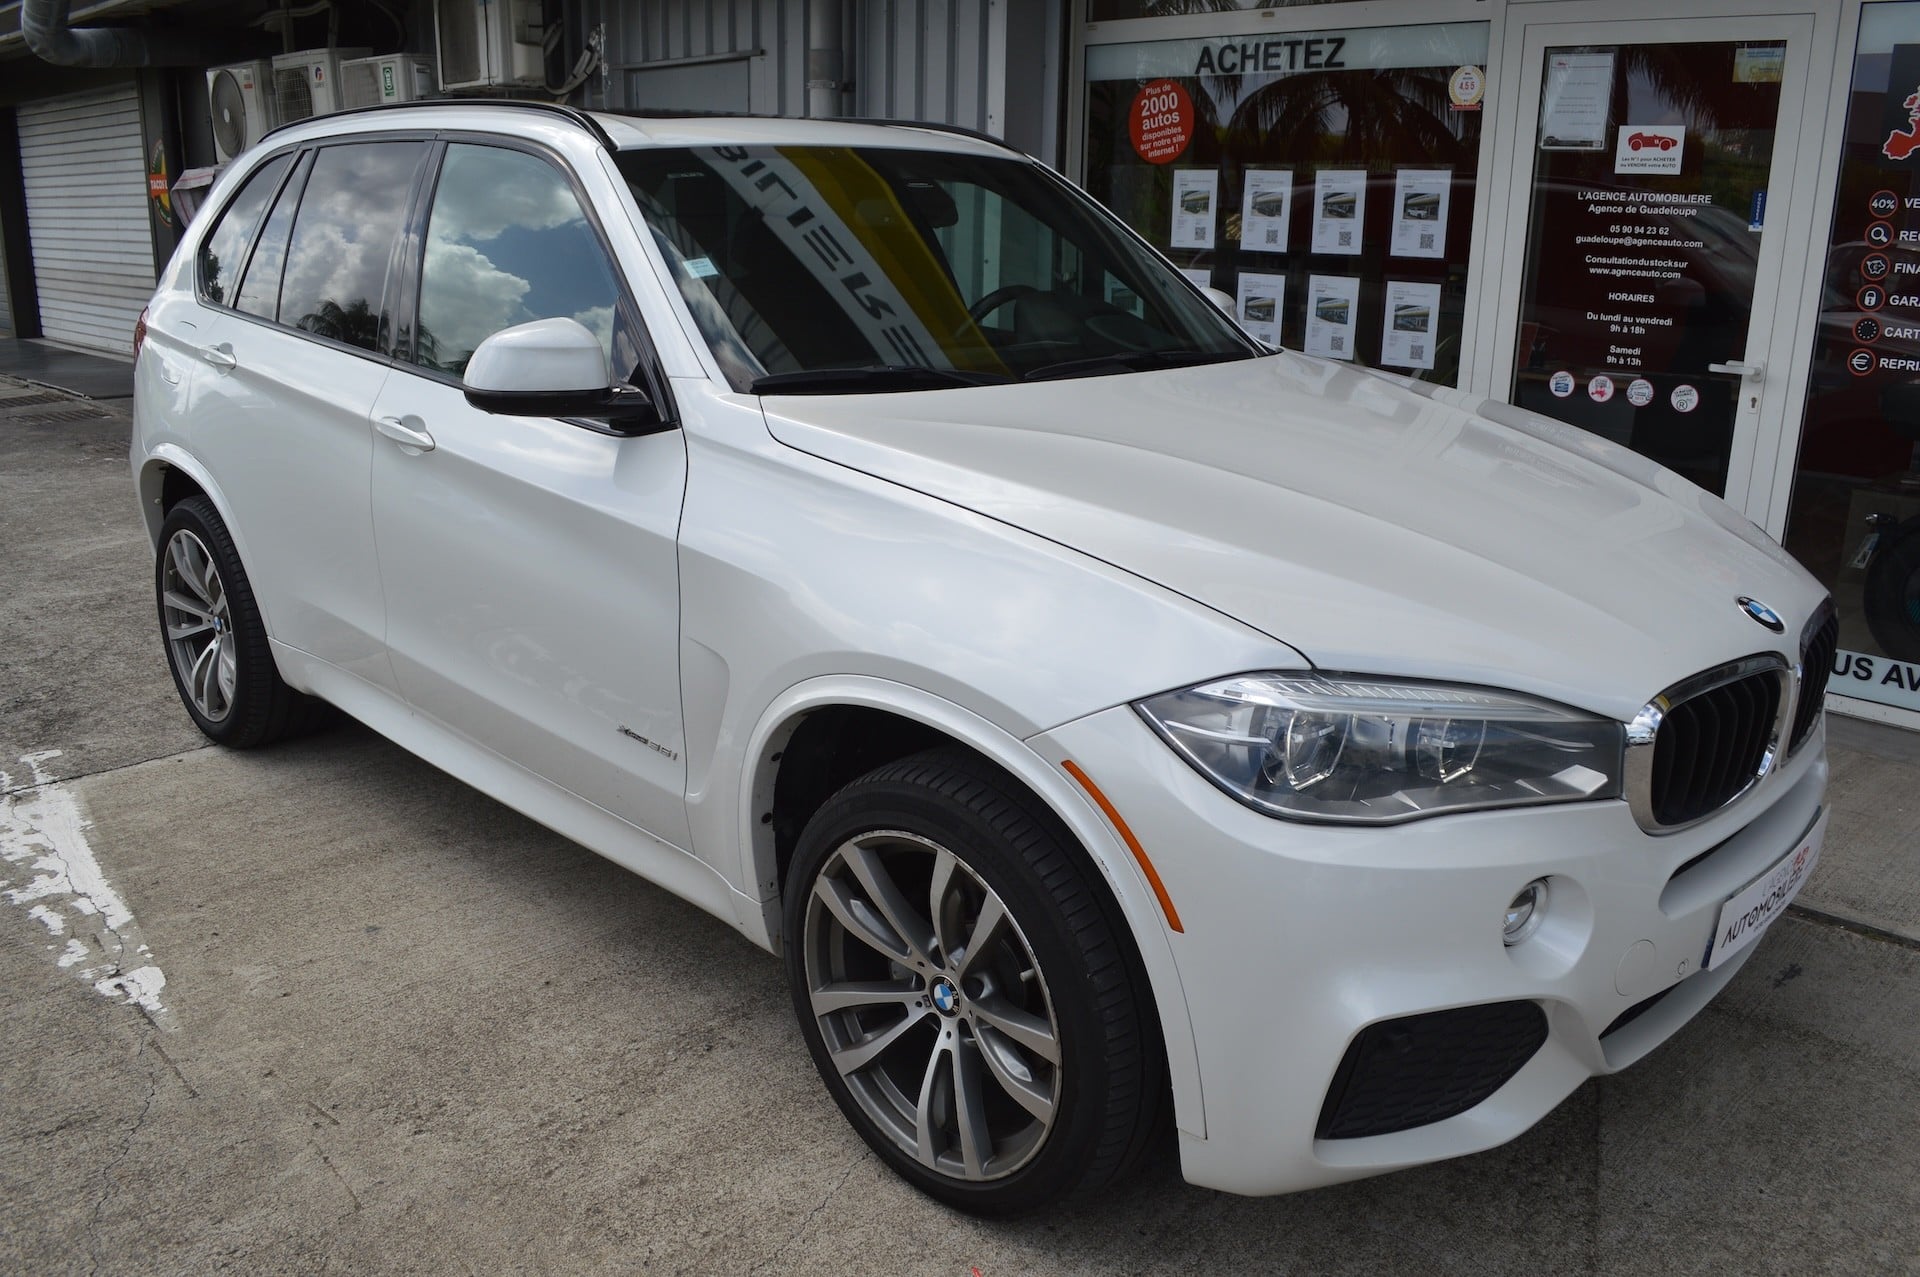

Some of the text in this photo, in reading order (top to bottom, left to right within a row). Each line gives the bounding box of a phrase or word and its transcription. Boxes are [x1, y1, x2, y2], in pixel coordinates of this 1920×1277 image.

[1194, 37, 1346, 75] ACHETEZ
[1145, 83, 1172, 96] Plus de
[1141, 92, 1179, 117] 2000
[1142, 111, 1180, 131] autos
[1141, 126, 1182, 141] disponibles
[1140, 133, 1186, 151] sur notre site
[1147, 145, 1175, 158] internet
[1577, 191, 1713, 204] L'AGENCE AUTOMOBILIERE
[1588, 203, 1698, 217] Agence de Guadeloupe
[1871, 199, 1895, 210] 40%
[1609, 225, 1670, 236] 05 90 94 23 62
[1575, 234, 1703, 248] guadeloupe@agenceauto.com
[1589, 266, 1681, 280] www.agenceauto.com
[1608, 292, 1655, 303] HORAIRES
[1586, 311, 1673, 326] Du lundi au vendredi
[1610, 324, 1646, 334] 9h à 18h
[1609, 344, 1641, 355] Samedi
[1606, 355, 1617, 364] 9h
[1626, 357, 1642, 366] 13h
